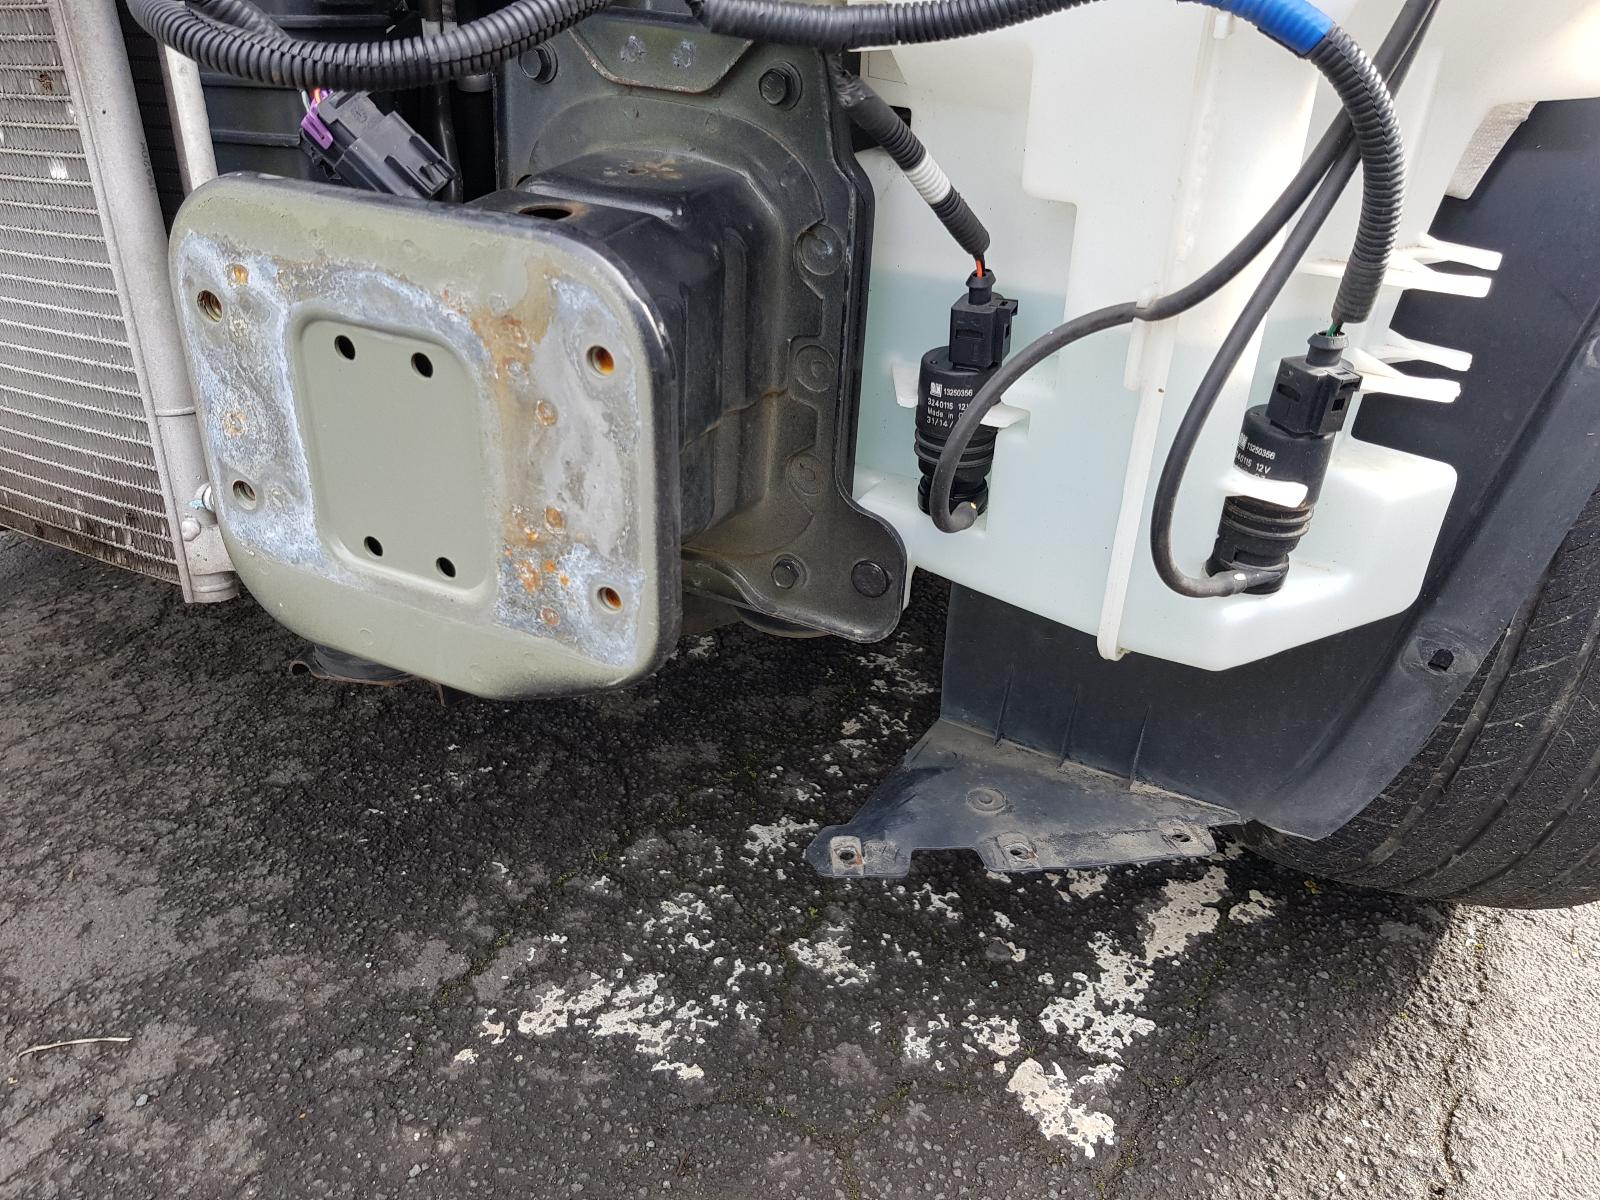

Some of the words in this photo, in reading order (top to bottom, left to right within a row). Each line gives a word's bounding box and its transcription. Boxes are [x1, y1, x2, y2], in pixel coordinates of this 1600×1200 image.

[944, 388, 973, 397] 13250356
[928, 398, 954, 410] 3240115
[927, 407, 944, 418] Made
